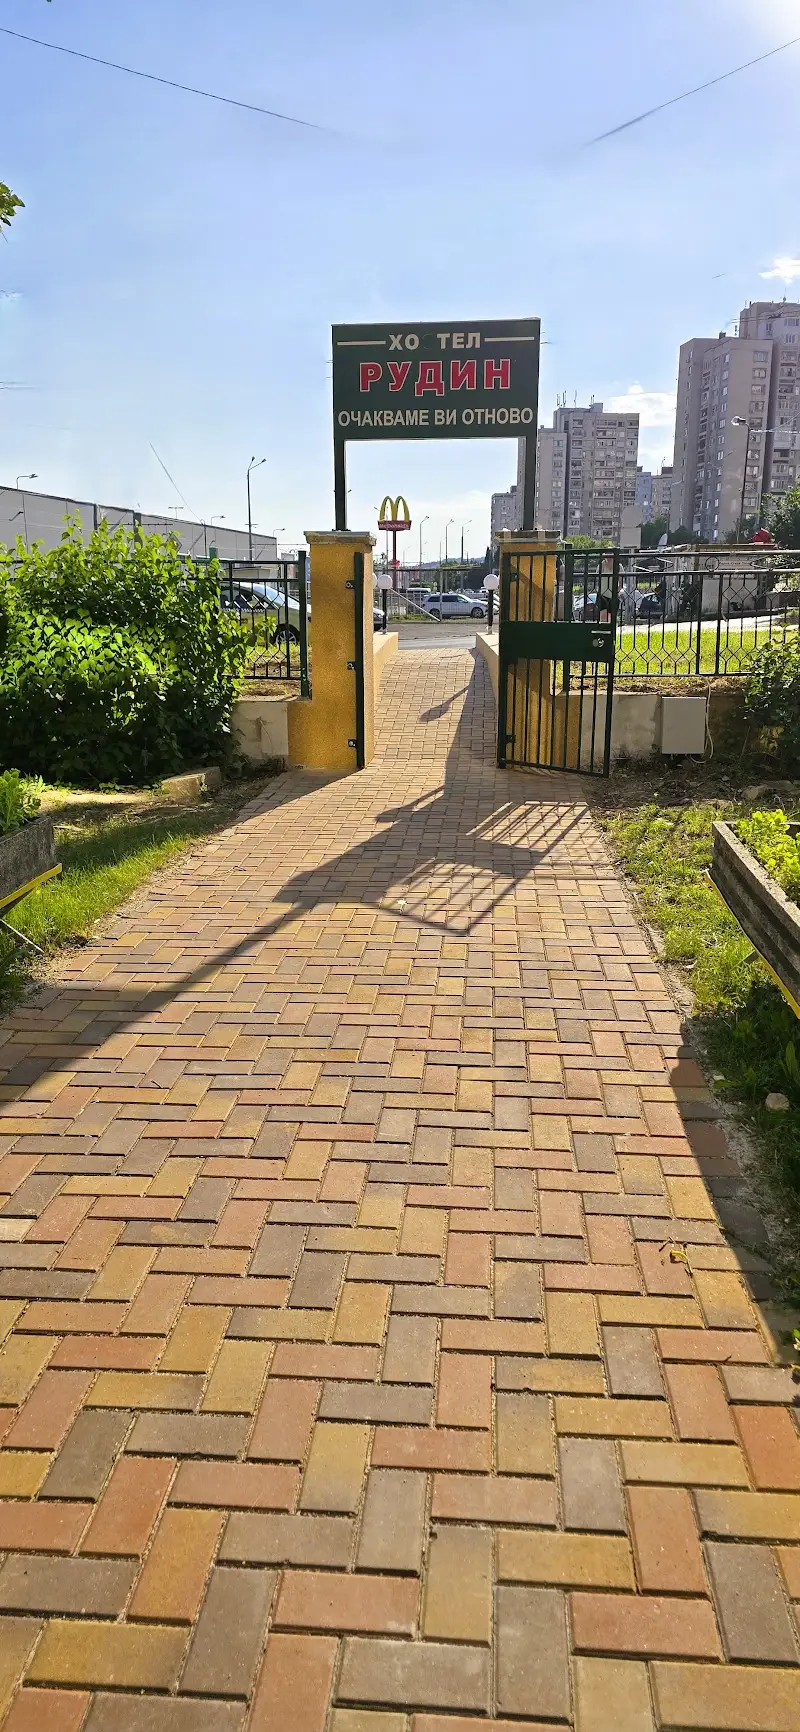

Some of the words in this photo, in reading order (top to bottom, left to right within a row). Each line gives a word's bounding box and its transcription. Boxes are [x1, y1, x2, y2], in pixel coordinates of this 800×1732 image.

[389, 333, 480, 350] ХОТЕЛ
[359, 358, 511, 397] РУДИН
[338, 410, 429, 427] ОЧАКВАМЕ
[434, 409, 457, 426] ВИ
[461, 407, 533, 425] ОТНОВО
